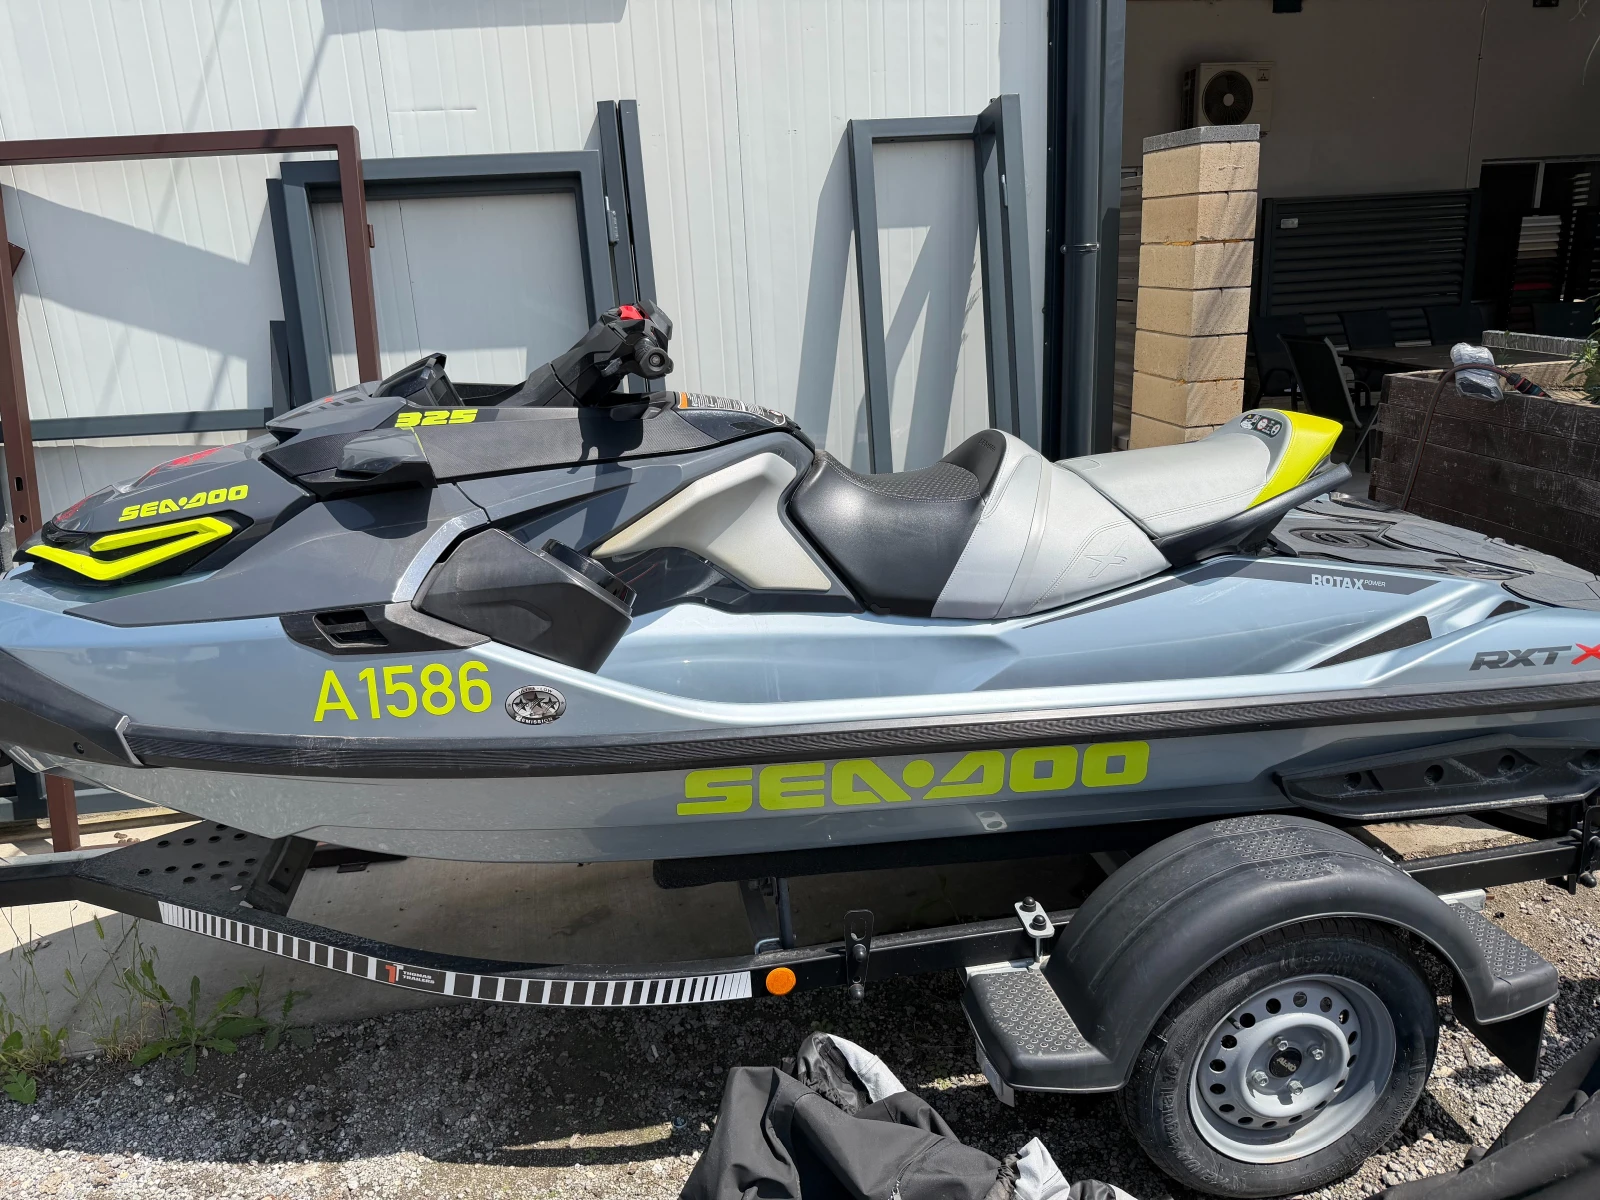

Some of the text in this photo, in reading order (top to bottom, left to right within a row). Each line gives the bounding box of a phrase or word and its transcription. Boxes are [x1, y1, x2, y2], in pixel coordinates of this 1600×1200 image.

[394, 408, 478, 428] 325
[1311, 573, 1386, 590] ROTAX POWER
[1468, 645, 1573, 671] RXT
[313, 660, 492, 722] A1586
[402, 971, 432, 980] THOMAS
[402, 974, 435, 985] TRAILERS
